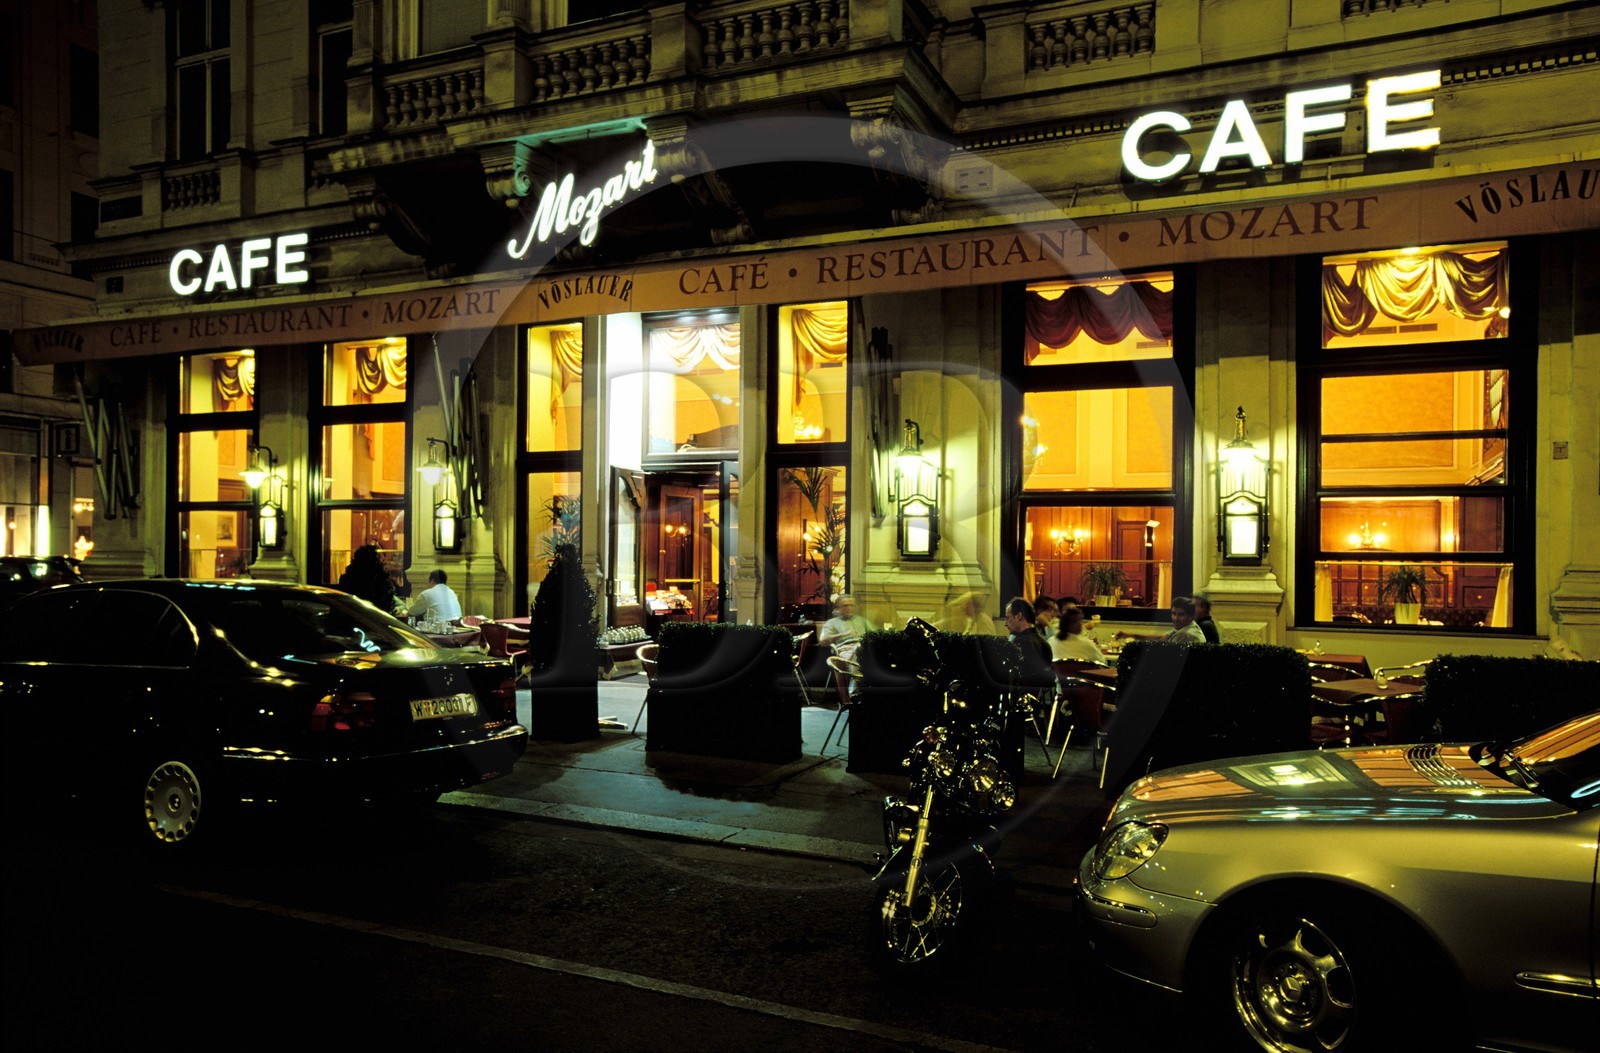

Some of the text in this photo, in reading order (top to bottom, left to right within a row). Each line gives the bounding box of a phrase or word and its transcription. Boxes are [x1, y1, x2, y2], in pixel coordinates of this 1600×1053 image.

[1121, 69, 1442, 181] CAFE
[507, 138, 658, 259] Mozart
[678, 195, 1379, 295] CAFÉ RESTAURANT MOZART
[168, 232, 309, 297] CAFE
[188, 304, 354, 338] RESTAURANT
[383, 289, 501, 324] MOZART
